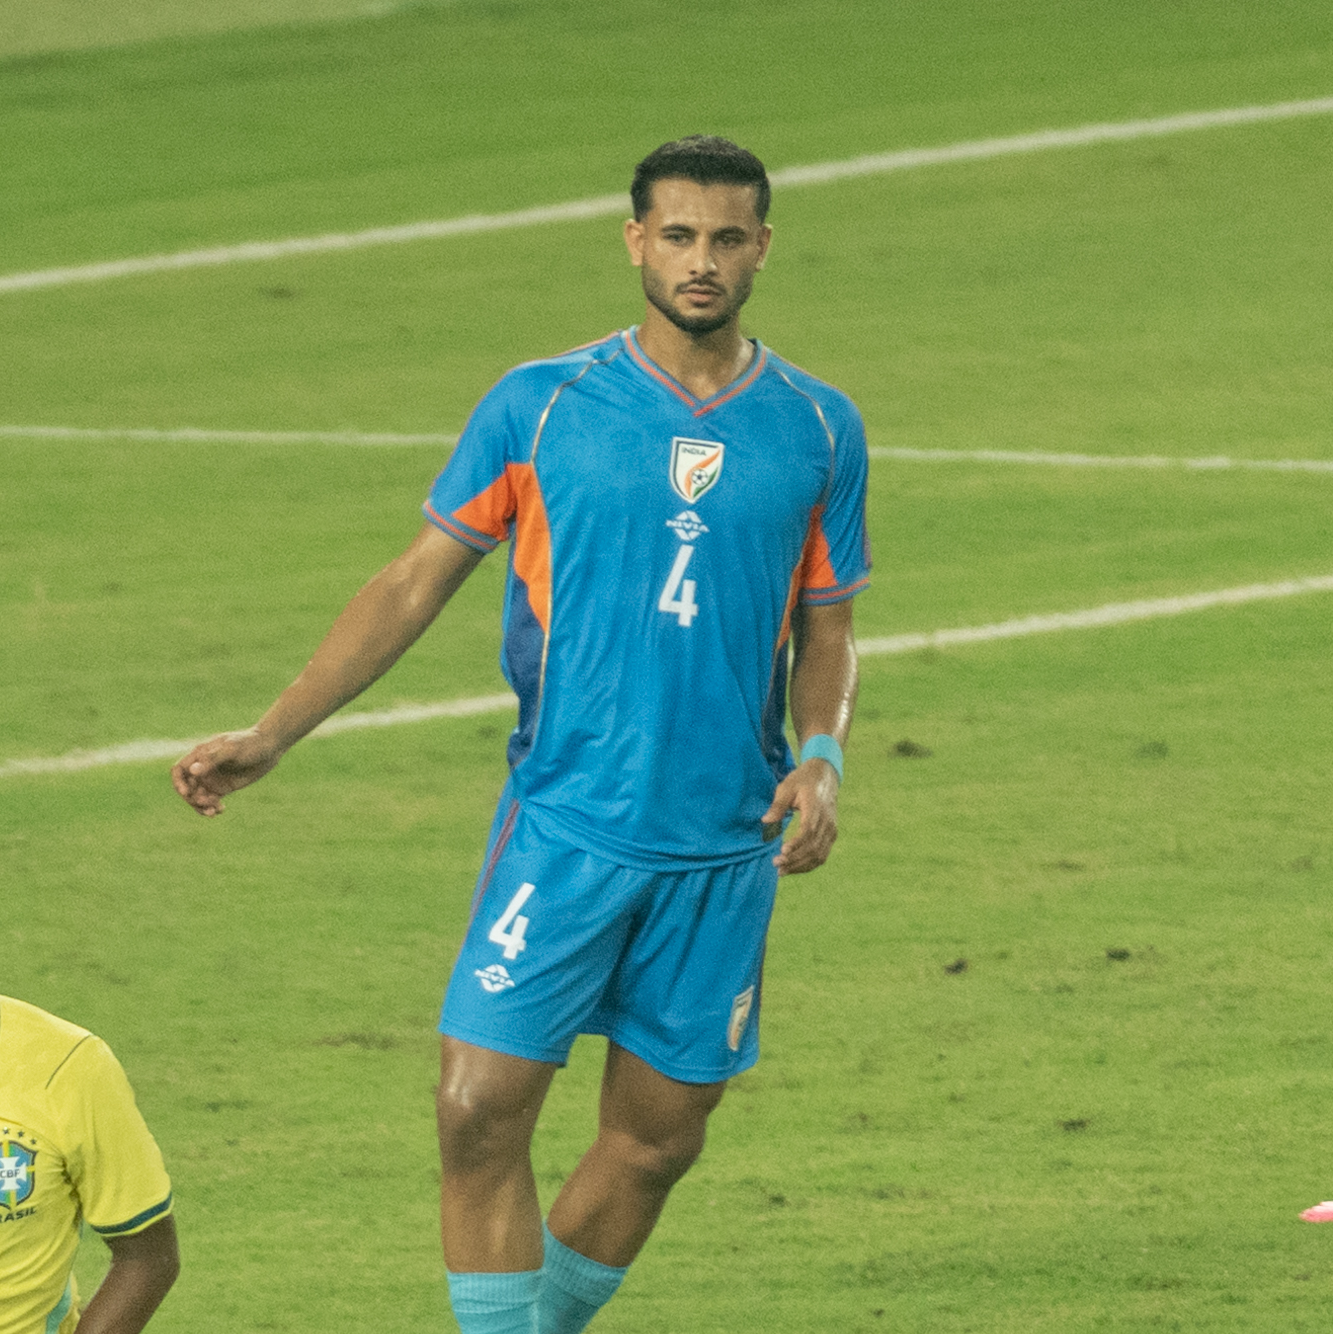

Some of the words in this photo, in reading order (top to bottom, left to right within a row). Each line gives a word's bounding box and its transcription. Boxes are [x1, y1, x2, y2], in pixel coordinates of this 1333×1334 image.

[658, 544, 699, 627] 4
[488, 882, 536, 960] 4
[0, 1168, 21, 1179] CBF
